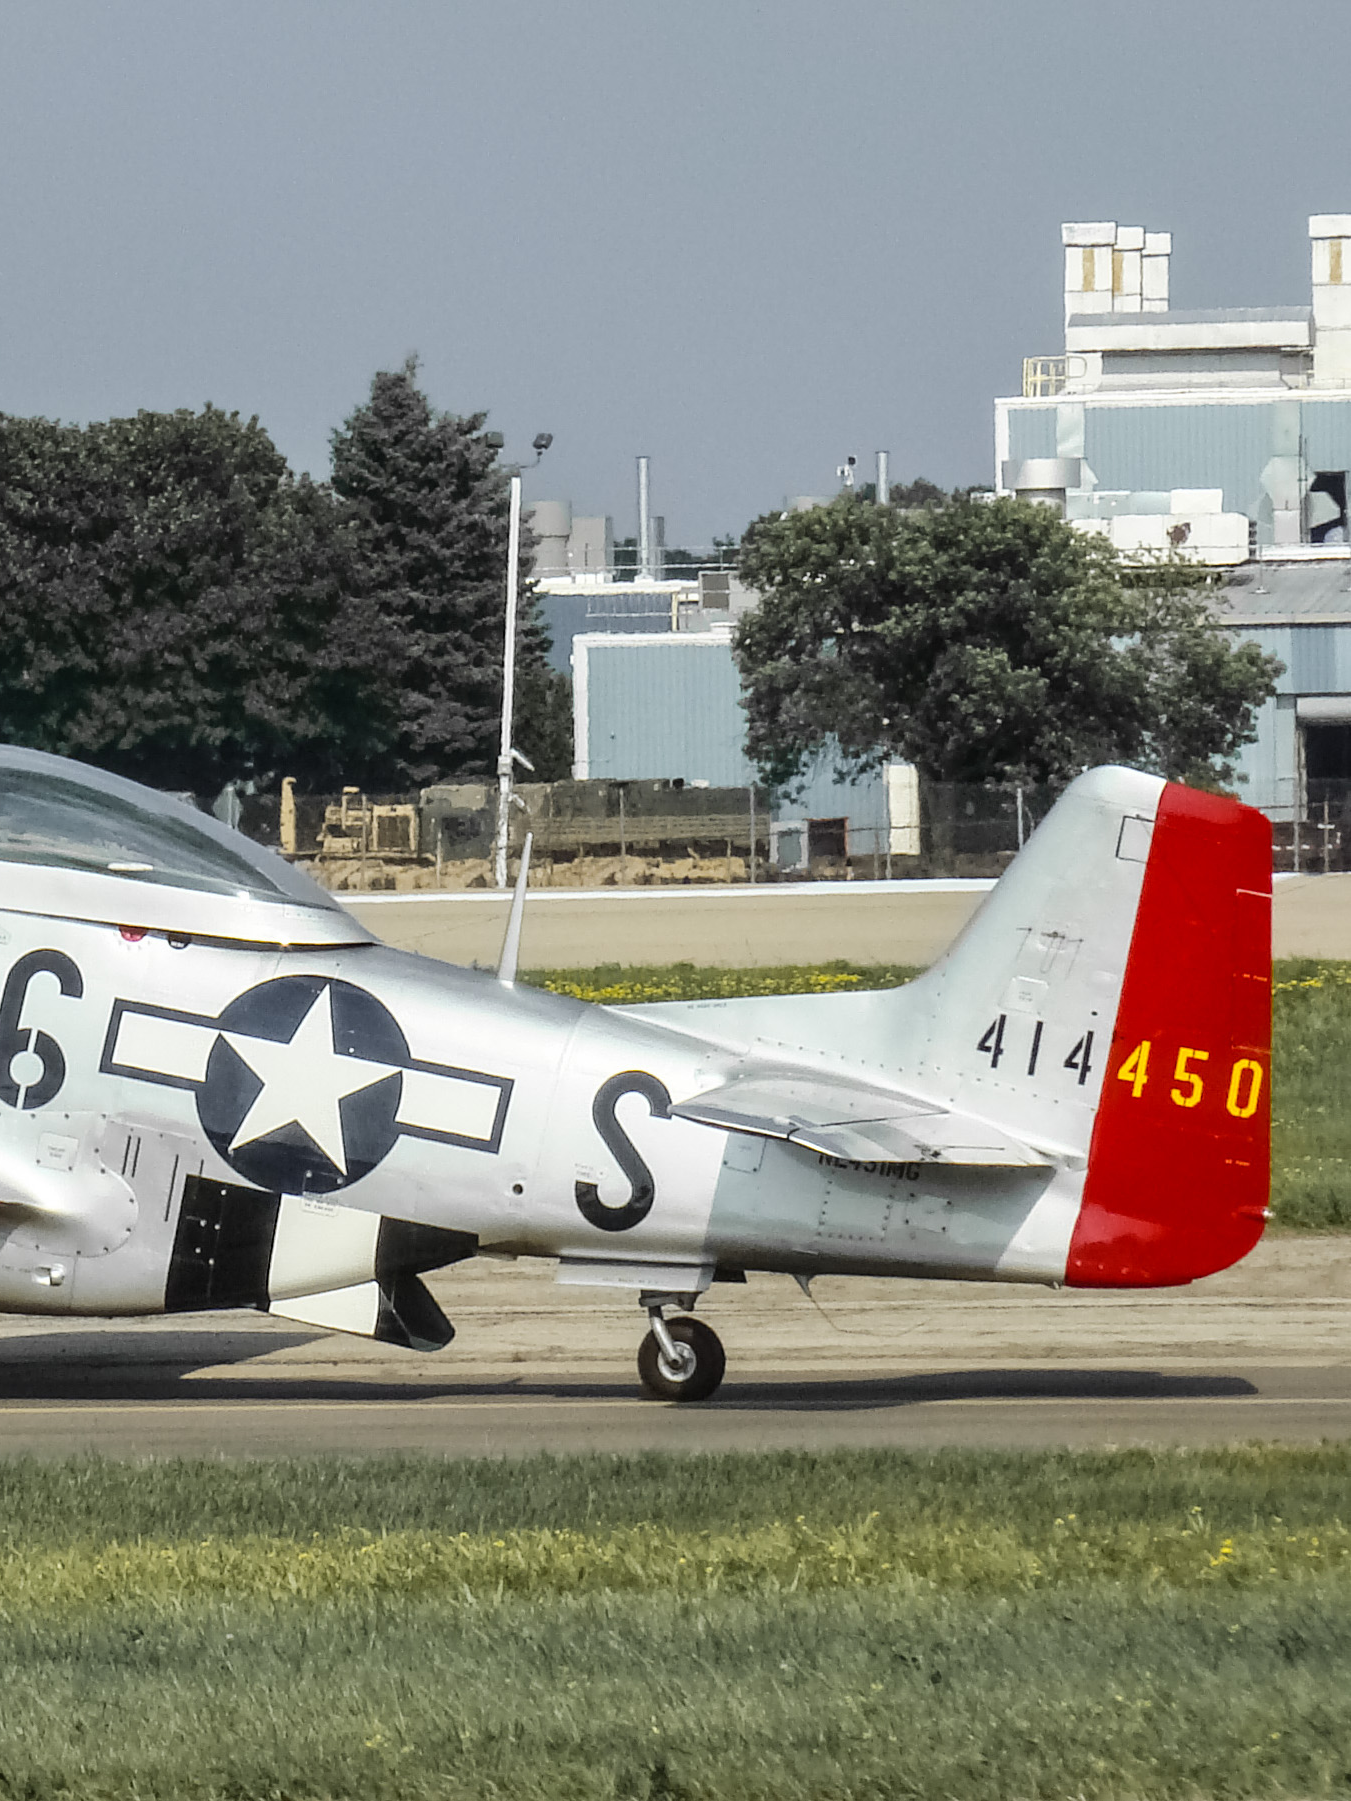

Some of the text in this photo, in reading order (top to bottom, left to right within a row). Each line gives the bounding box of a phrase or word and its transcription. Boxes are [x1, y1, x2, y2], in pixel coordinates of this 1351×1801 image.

[976, 1014, 1264, 1118] 414 450
[575, 1070, 672, 1232] S
